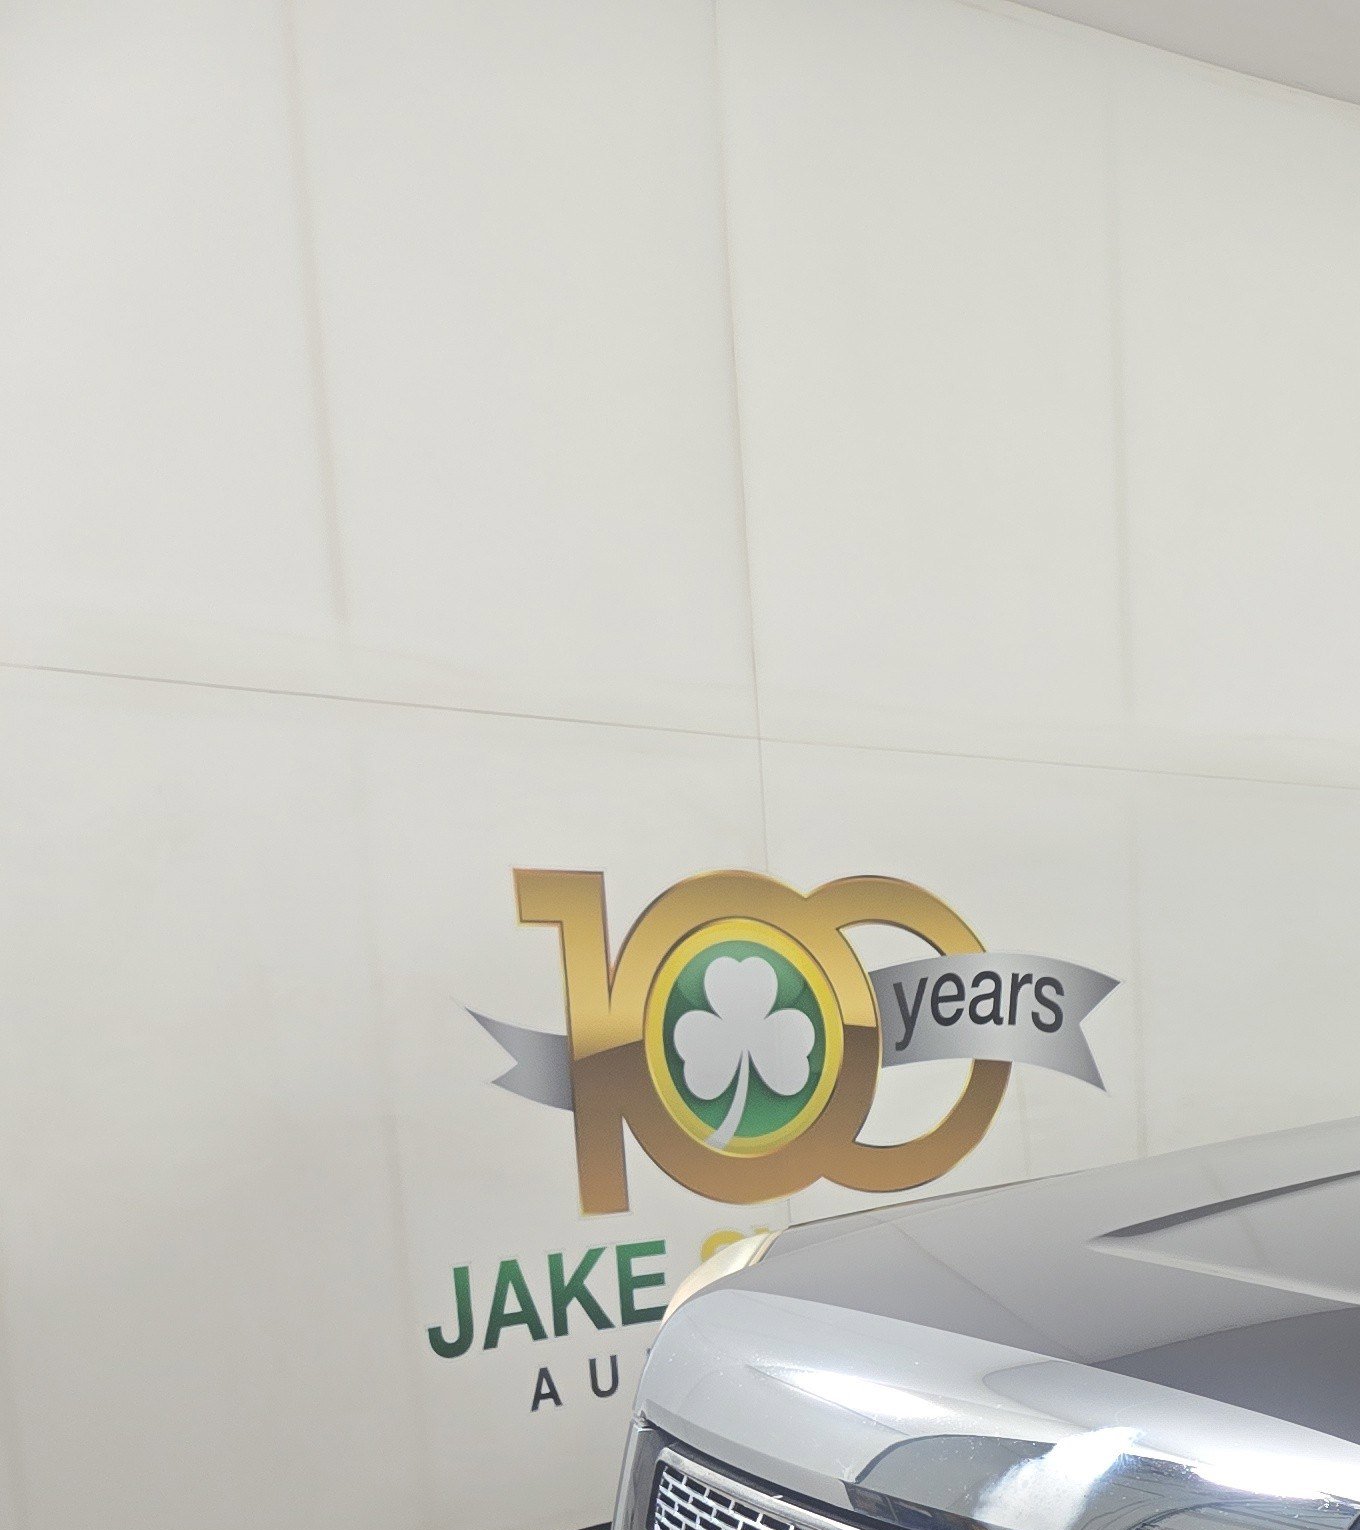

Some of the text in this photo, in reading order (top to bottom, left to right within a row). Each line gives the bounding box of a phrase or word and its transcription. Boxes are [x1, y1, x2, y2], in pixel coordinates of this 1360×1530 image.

[511, 867, 1013, 1215] 100
[892, 970, 1065, 1052] years
[427, 1239, 668, 1358] JAKE
[530, 1348, 652, 1412] AU
